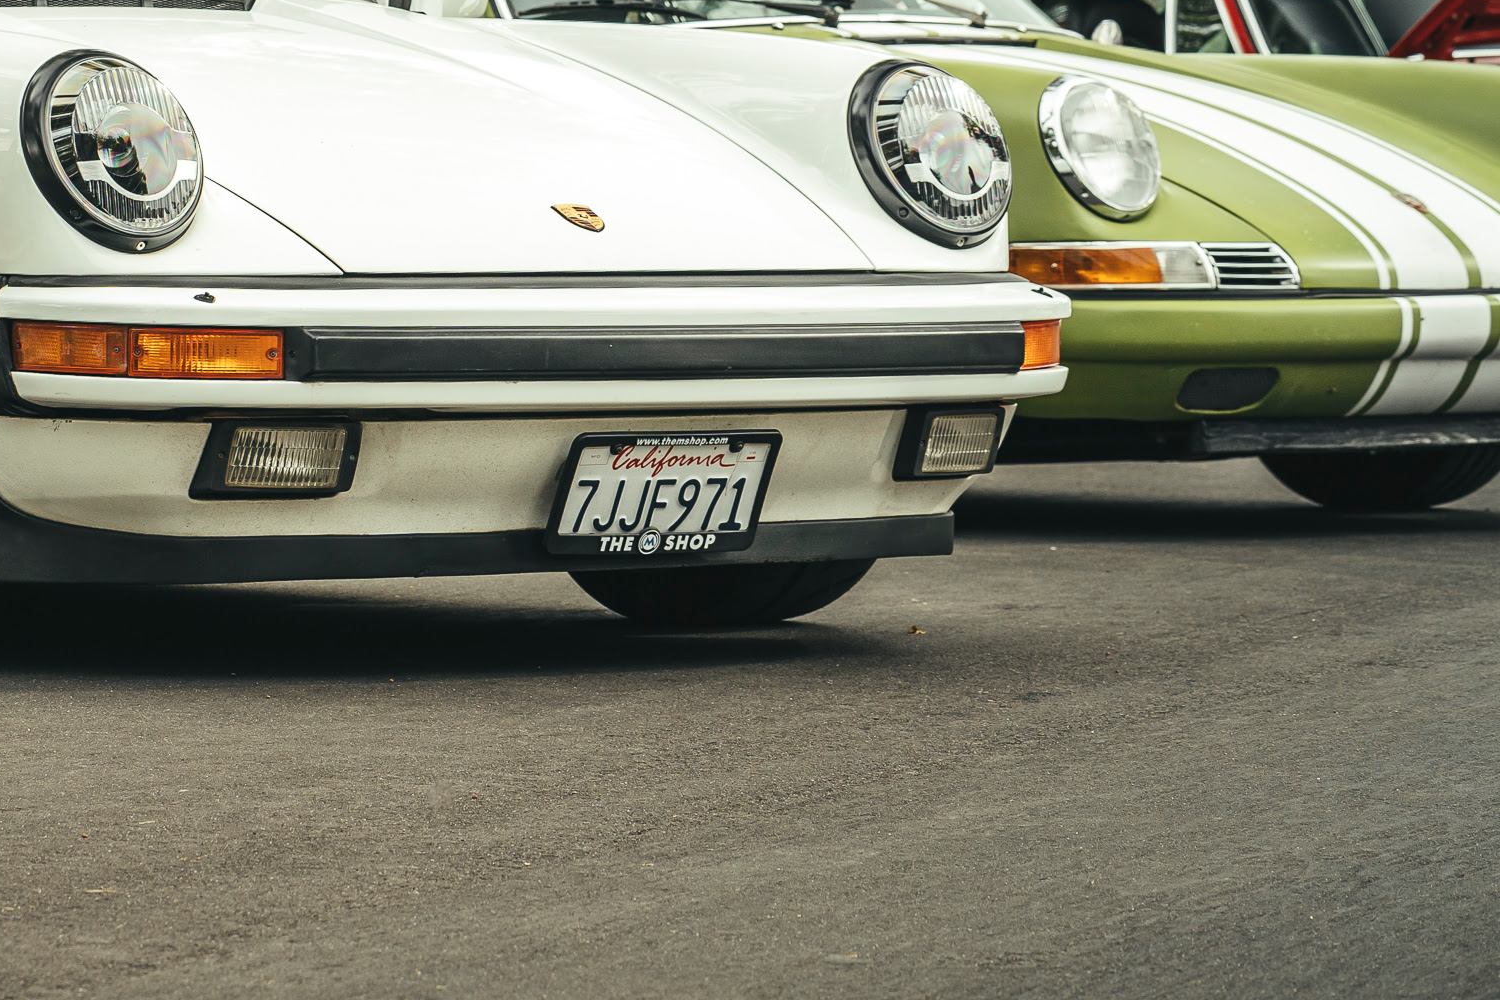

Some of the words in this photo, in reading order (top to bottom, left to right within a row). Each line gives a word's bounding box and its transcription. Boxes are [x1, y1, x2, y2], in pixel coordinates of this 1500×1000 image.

[636, 436, 729, 447] www.themshop.com
[612, 445, 735, 477] California
[572, 477, 747, 533] 7JJF971
[600, 536, 635, 552] THE
[663, 534, 717, 551] SHOP
